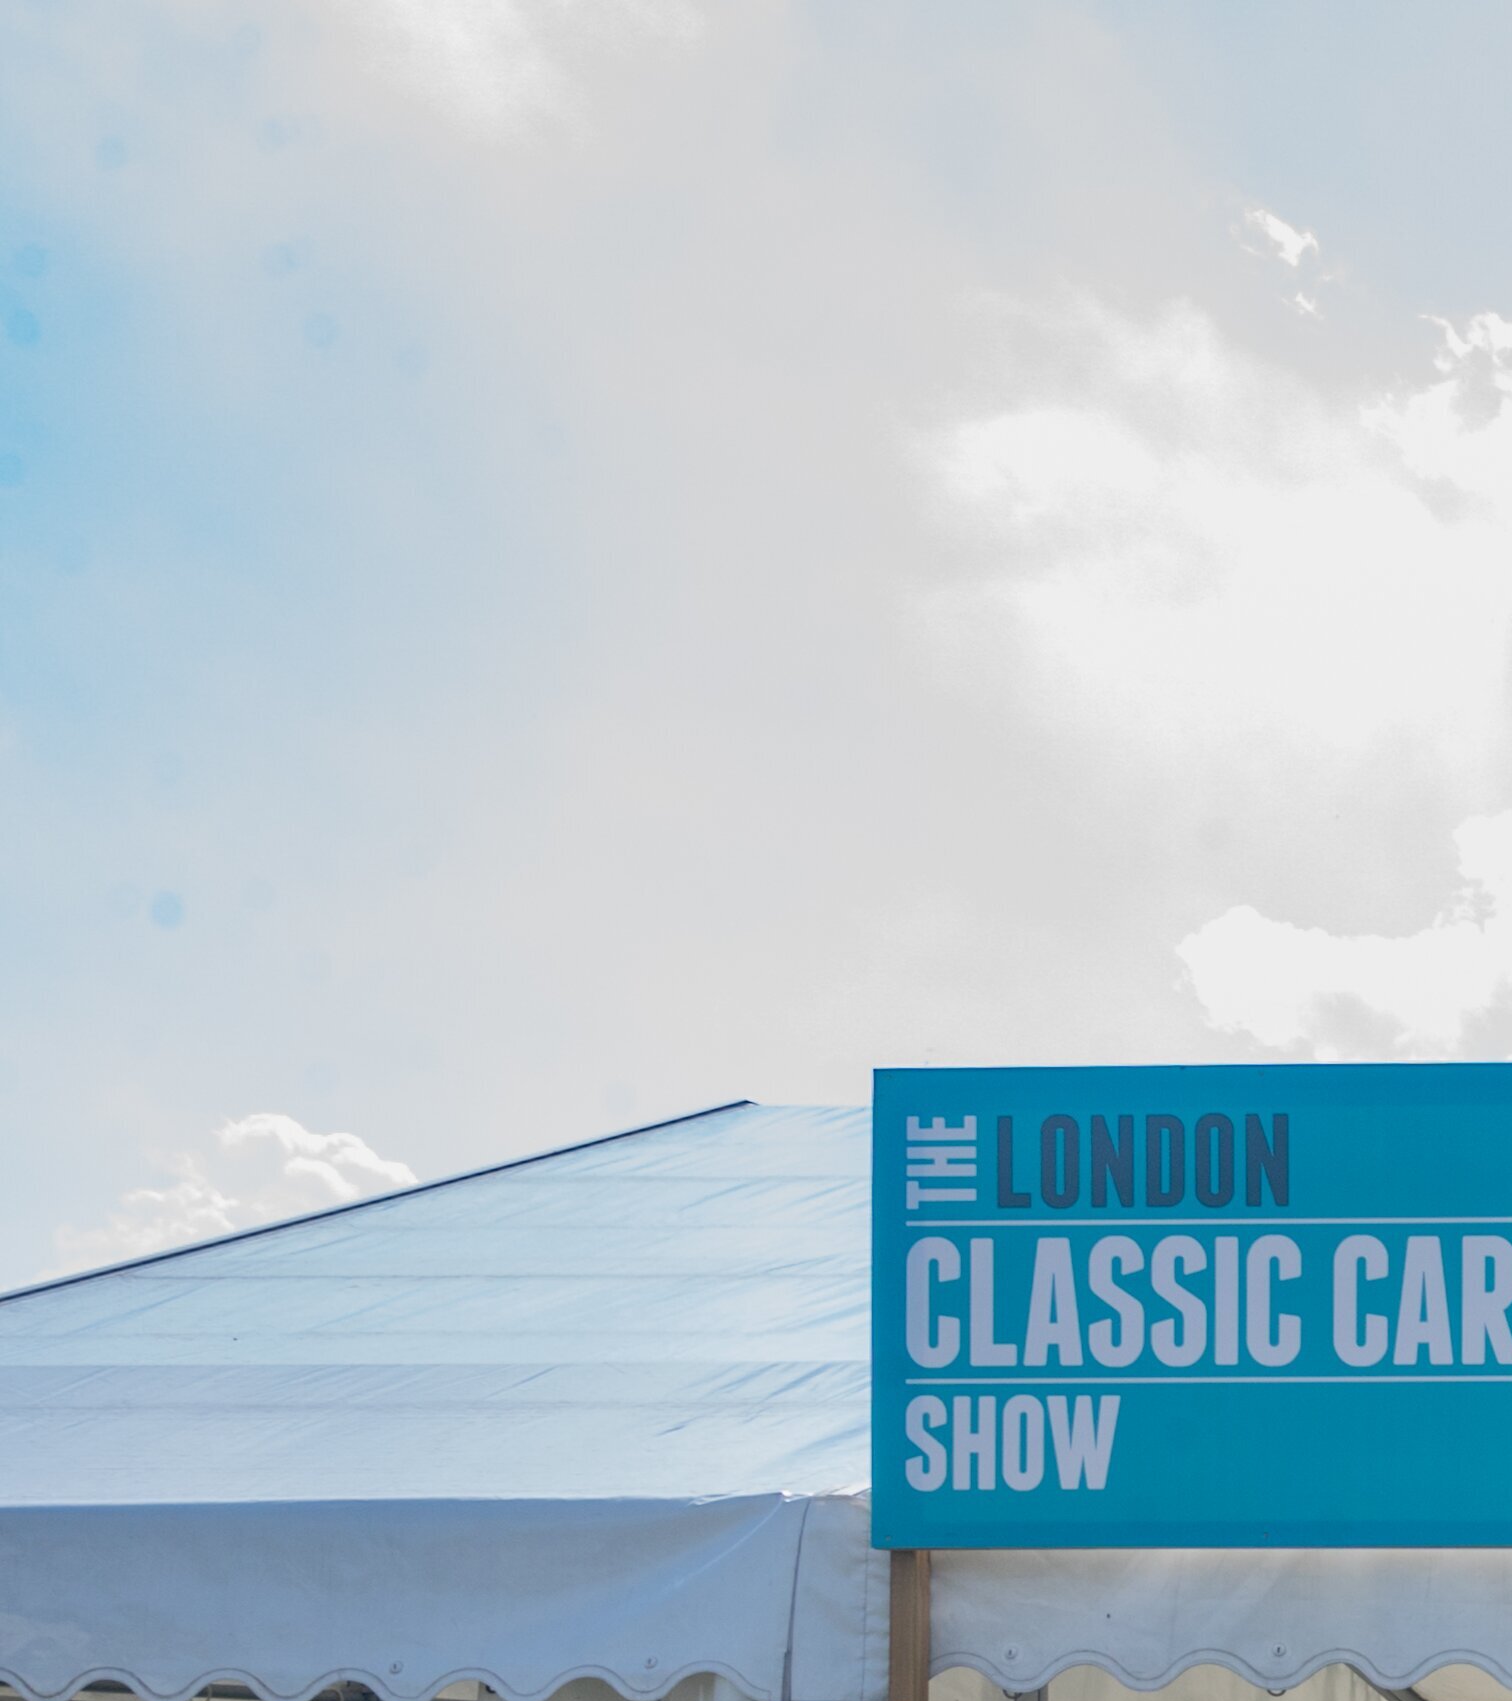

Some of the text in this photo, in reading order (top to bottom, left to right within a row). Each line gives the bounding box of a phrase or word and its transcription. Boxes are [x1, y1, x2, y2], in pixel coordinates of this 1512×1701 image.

[905, 1114, 977, 1210] THE
[995, 1112, 1290, 1209] LONDON
[904, 1233, 1303, 1369] CLASSIC
[904, 1393, 1121, 1492] SHOW
